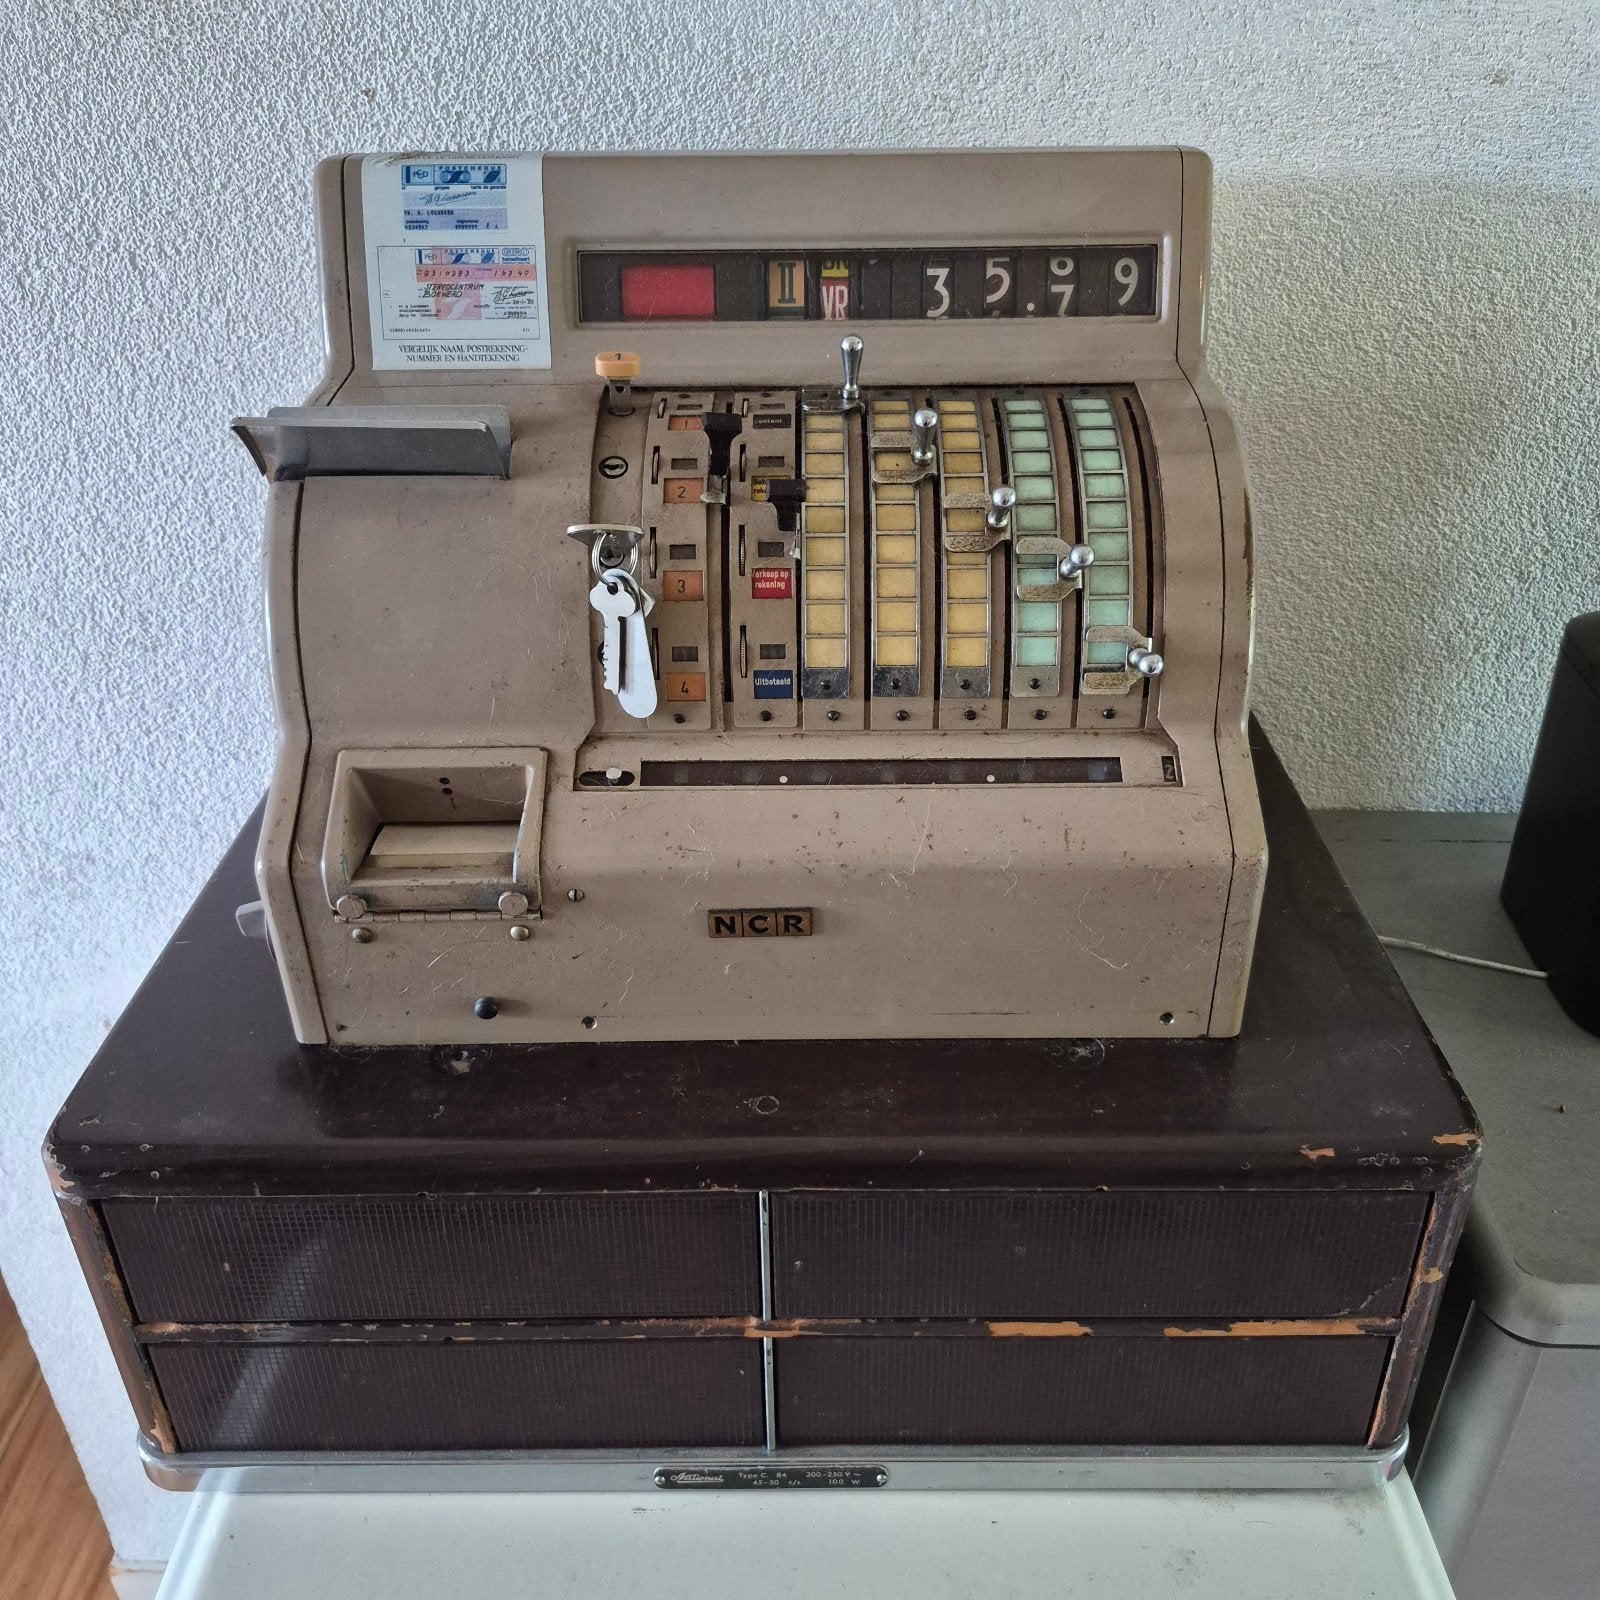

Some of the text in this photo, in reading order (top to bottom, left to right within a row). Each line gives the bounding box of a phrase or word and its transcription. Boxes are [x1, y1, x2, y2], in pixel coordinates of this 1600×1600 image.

[424, 283, 485, 291] STEREOCENTRUM
[399, 345, 439, 354] VERGELIJK
[677, 485, 687, 498] 2
[780, 571, 789, 579] op
[677, 579, 686, 593] 3
[755, 580, 786, 590] rekening
[755, 677, 791, 686] Uitbetaald
[681, 681, 689, 694] 4
[714, 914, 805, 935] NCR
[670, 1472, 724, 1484] National
